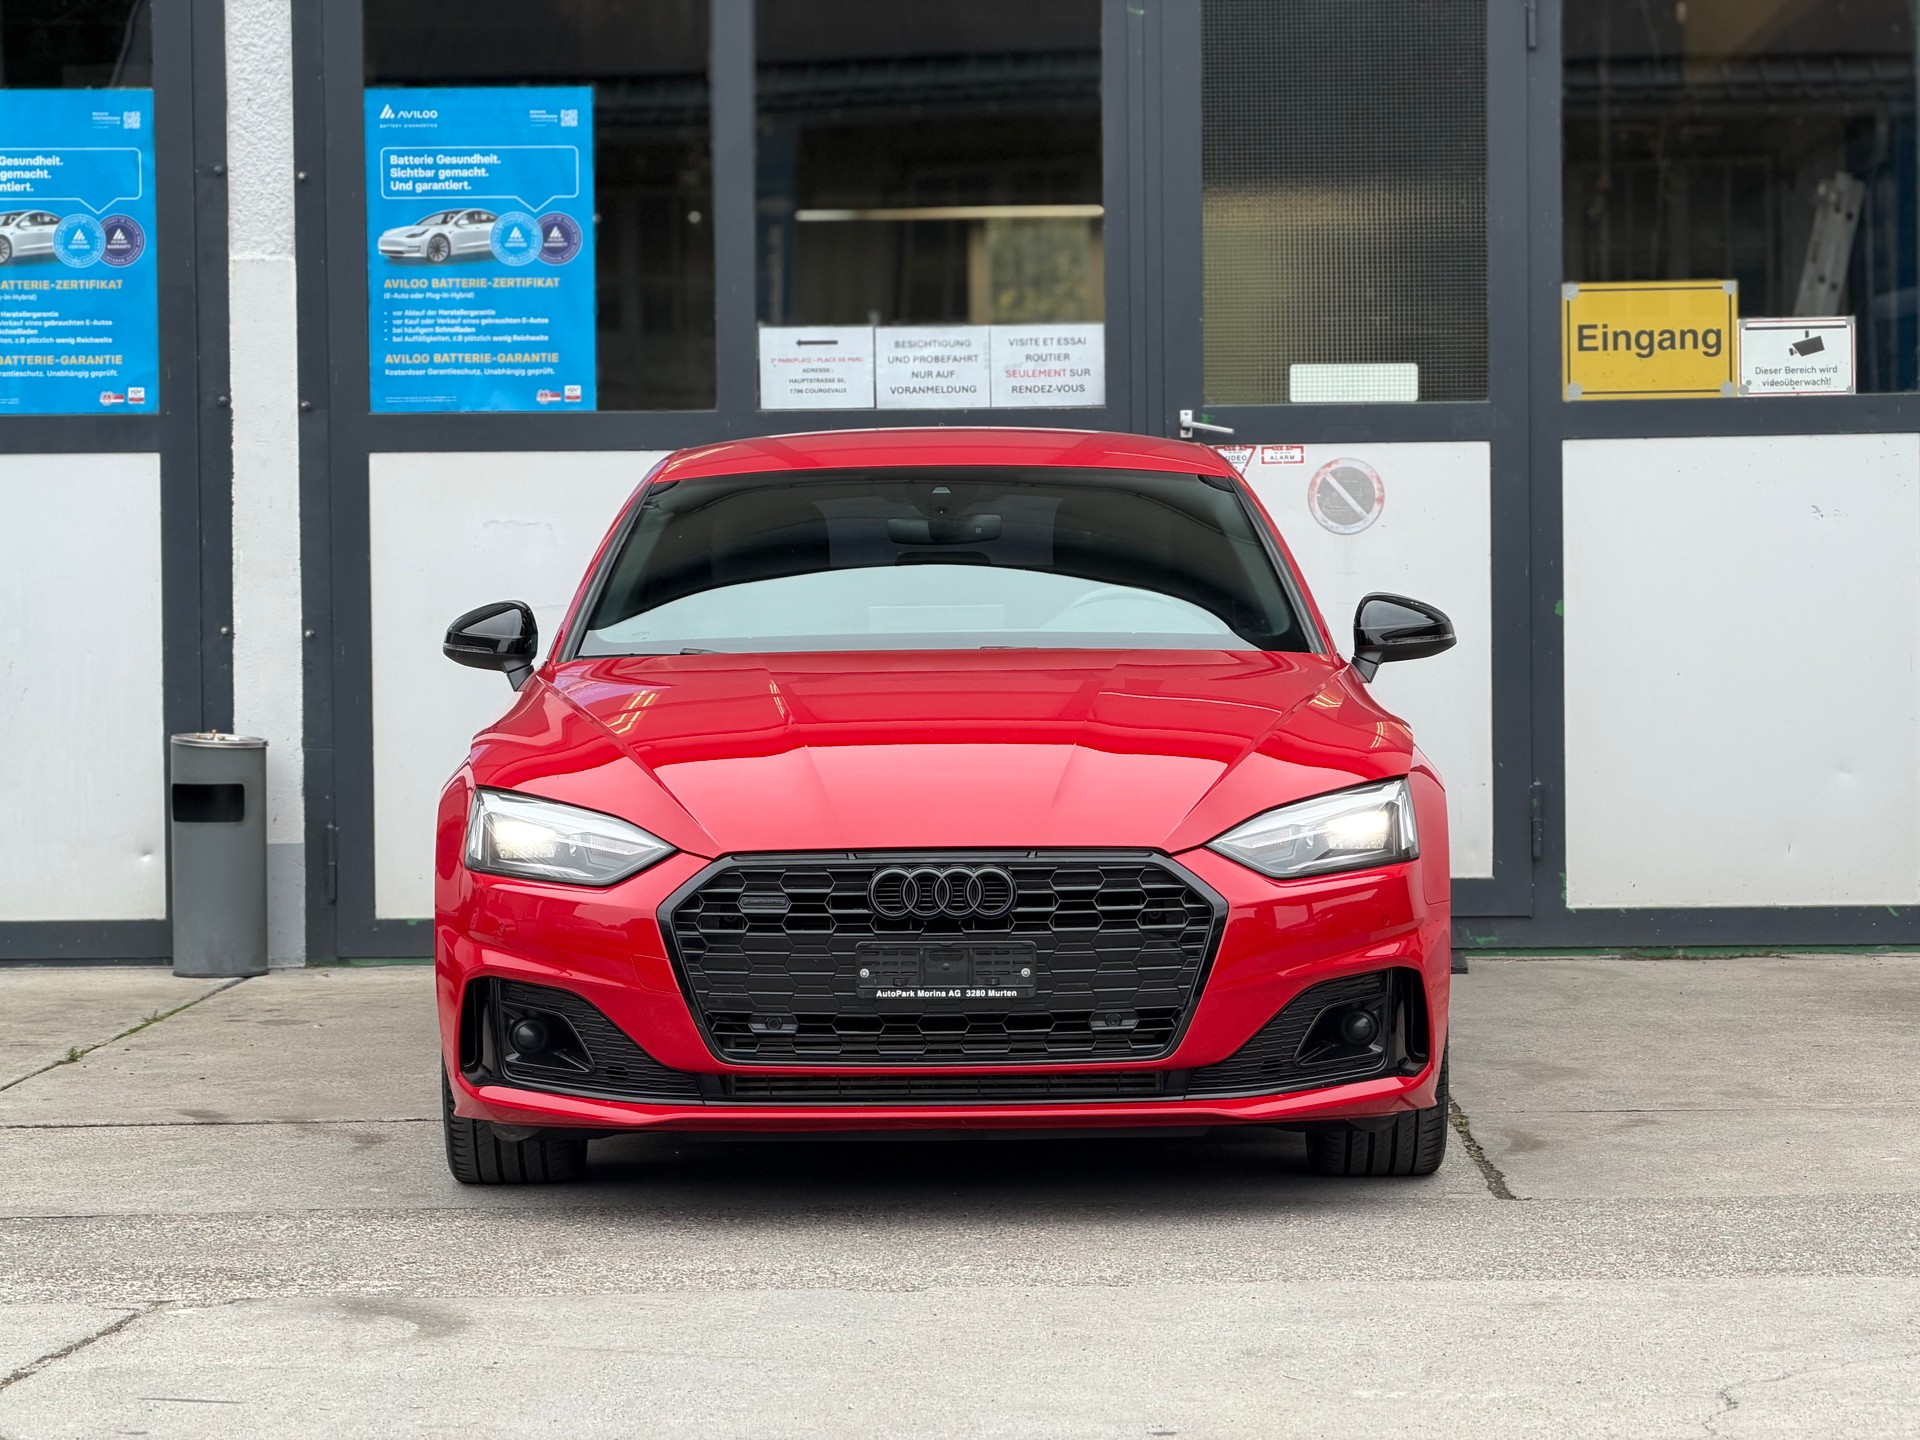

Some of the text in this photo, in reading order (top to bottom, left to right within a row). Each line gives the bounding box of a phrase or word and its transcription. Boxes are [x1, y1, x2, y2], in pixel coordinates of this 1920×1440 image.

[397, 110, 438, 119] AVILOO
[0, 154, 64, 166] Gesundheit.
[390, 153, 501, 165] Batterie Gesundheit.
[0, 168, 52, 181] gemacht.
[390, 167, 489, 180] Sichtbar gemacht.
[390, 180, 472, 193] Und garantiert.
[0, 279, 123, 290] ATTERIE-ZERTIFIKAT
[384, 277, 560, 289] AVILOO BATTERIE-ZERTIFIKAT
[0, 293, 37, 301] -in-Hybrid)
[426, 291, 475, 300] Plug-in-Hybrid)
[894, 339, 972, 349] BESICHTIGUNG
[1008, 337, 1086, 346] VISITE ET ESSAI
[1577, 323, 1722, 359] Eingang
[384, 352, 559, 364] AVILOO BATTERIE-GARANTIE
[887, 354, 979, 364] UND PROBEFAHRT
[1025, 353, 1071, 362] ROUTIER
[47, 369, 89, 378] Unabhängig
[90, 369, 119, 378] geprüft.
[427, 368, 483, 376] Garantieschutz.
[484, 367, 525, 376] Unabhängig
[527, 366, 556, 376] geprüft.
[911, 370, 956, 379] NUR AUF
[1005, 368, 1091, 378] SEULEMENT SUR
[1755, 365, 1838, 375] Dieser Bereich wird
[1762, 376, 1832, 387] videoüberwacht!
[889, 385, 977, 395] VORANMELDUNG
[1011, 384, 1086, 394] RENDEZ-VOUS
[876, 989, 1017, 997] AutoPark Morina AG 3280 Murten
